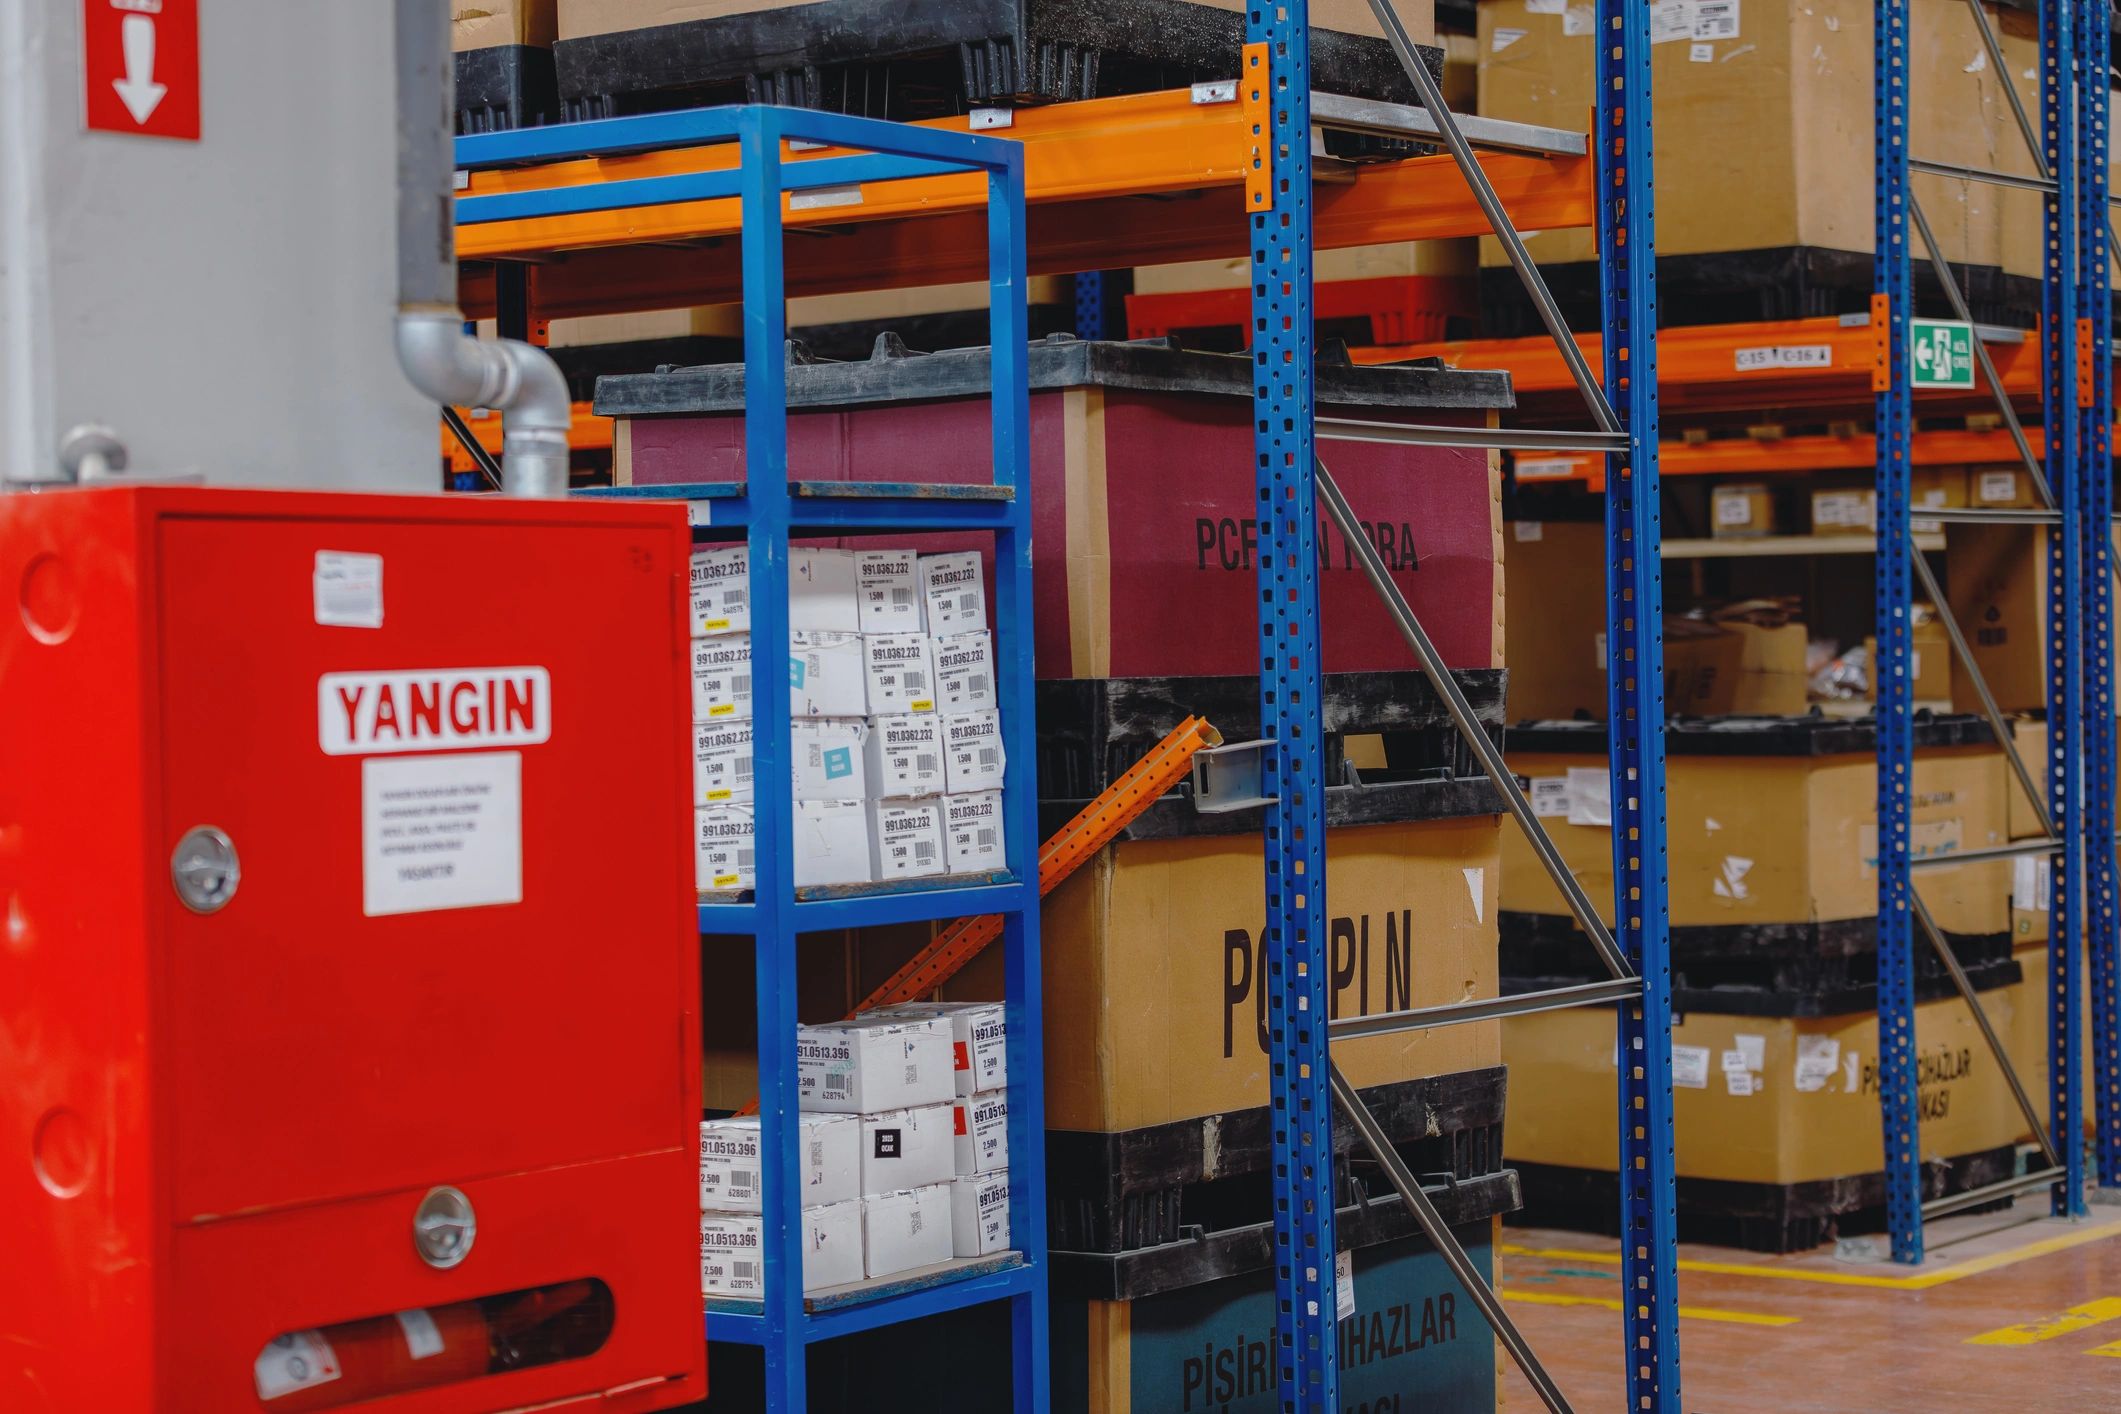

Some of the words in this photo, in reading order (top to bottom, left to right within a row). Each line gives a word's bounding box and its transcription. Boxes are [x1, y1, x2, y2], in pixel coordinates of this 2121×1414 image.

[690, 561, 746, 581] 91.0362.232
[862, 563, 909, 575] 991.0362.232
[931, 568, 975, 586] 991.0362.232
[869, 591, 884, 601] 1.500
[694, 600, 712, 610] 1.500
[938, 600, 952, 610] 1.500
[872, 647, 920, 660] 991.0362.232
[940, 649, 984, 667] 991.0362.232
[703, 680, 721, 691] 1.500
[880, 676, 895, 685] 1.500
[946, 681, 960, 691] 1.500
[338, 678, 534, 742] YANGIN
[887, 729, 933, 742] 991.0362.232
[951, 723, 994, 739] 991.0362.232
[893, 758, 908, 767] 1.500
[958, 753, 972, 763] 1.500
[706, 763, 724, 774] 1.500
[950, 804, 992, 819] 991.0362.232
[885, 816, 931, 831] 991.0362.232
[703, 823, 754, 837] 991.0362.23
[956, 834, 970, 844] 1.500
[892, 846, 907, 857] 1.500
[709, 853, 727, 863] 1.500
[975, 1023, 1006, 1041] 991.0513
[797, 1045, 850, 1060] 91.0513.396
[983, 1057, 997, 1068] 2.500
[822, 1091, 845, 1100] 628794
[974, 1104, 1007, 1123] 991.0513.
[701, 1141, 756, 1156] 91.0513.396
[983, 1138, 997, 1150] 2.500
[700, 1174, 720, 1184] 2.500
[728, 1188, 751, 1198] 628801
[980, 1185, 1009, 1206] 991.0513.
[986, 1222, 999, 1234] 2.500
[704, 1266, 723, 1276] 2.500
[1336, 1266, 1345, 1278] 50
[730, 1280, 753, 1289] 628795
